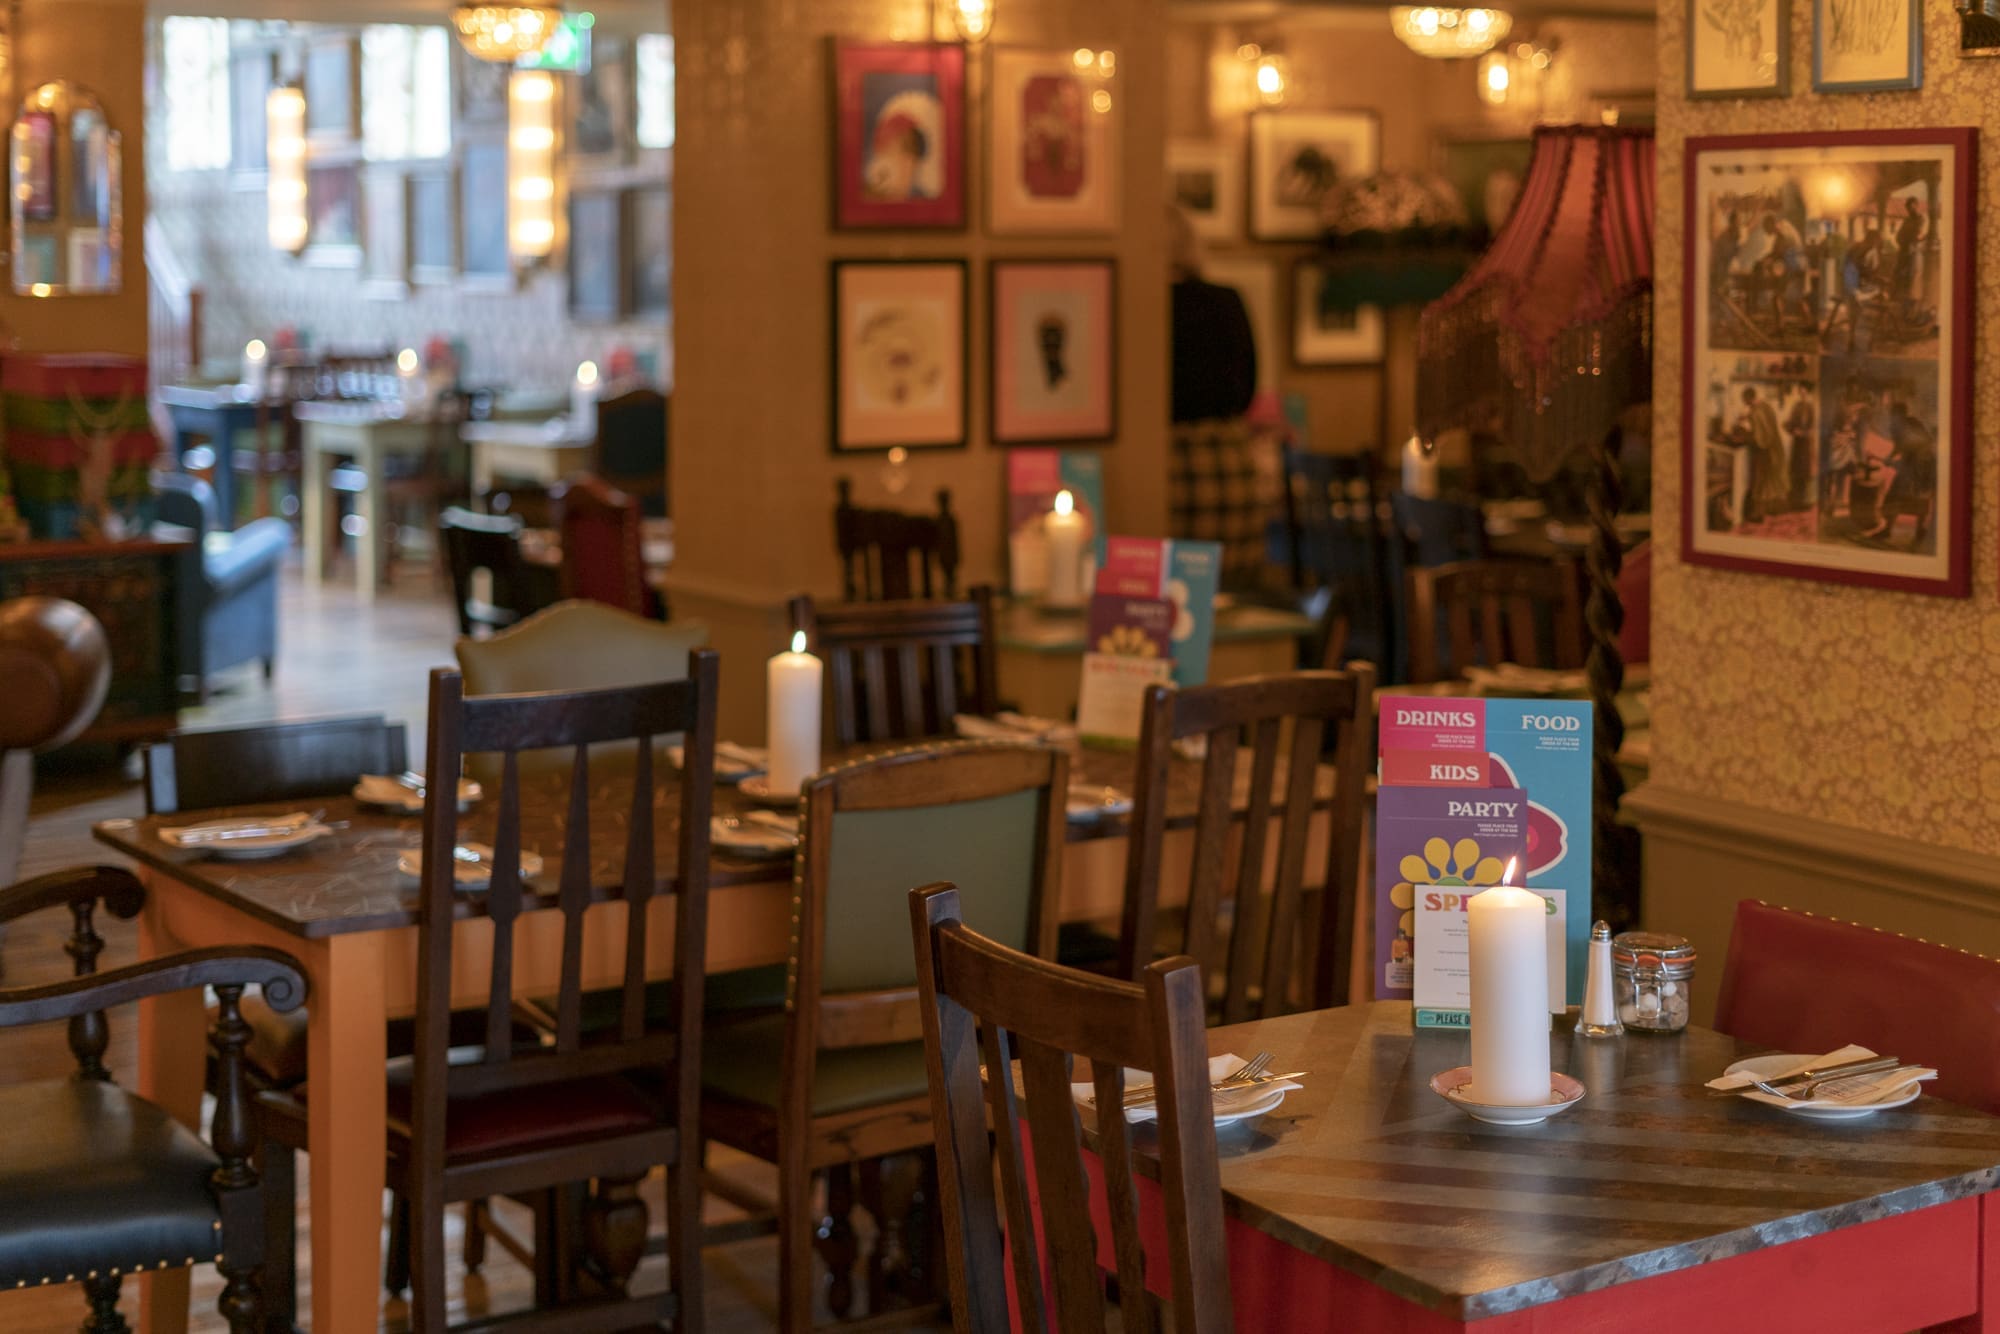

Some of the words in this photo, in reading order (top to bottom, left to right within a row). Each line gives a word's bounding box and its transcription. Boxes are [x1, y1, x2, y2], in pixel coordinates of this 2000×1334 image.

[1396, 710, 1476, 728] DRINKS
[1521, 714, 1580, 731] FOOD
[1429, 764, 1480, 781] KIDS
[1447, 801, 1519, 817] PARTY
[1435, 1013, 1463, 1025] PLEASE
